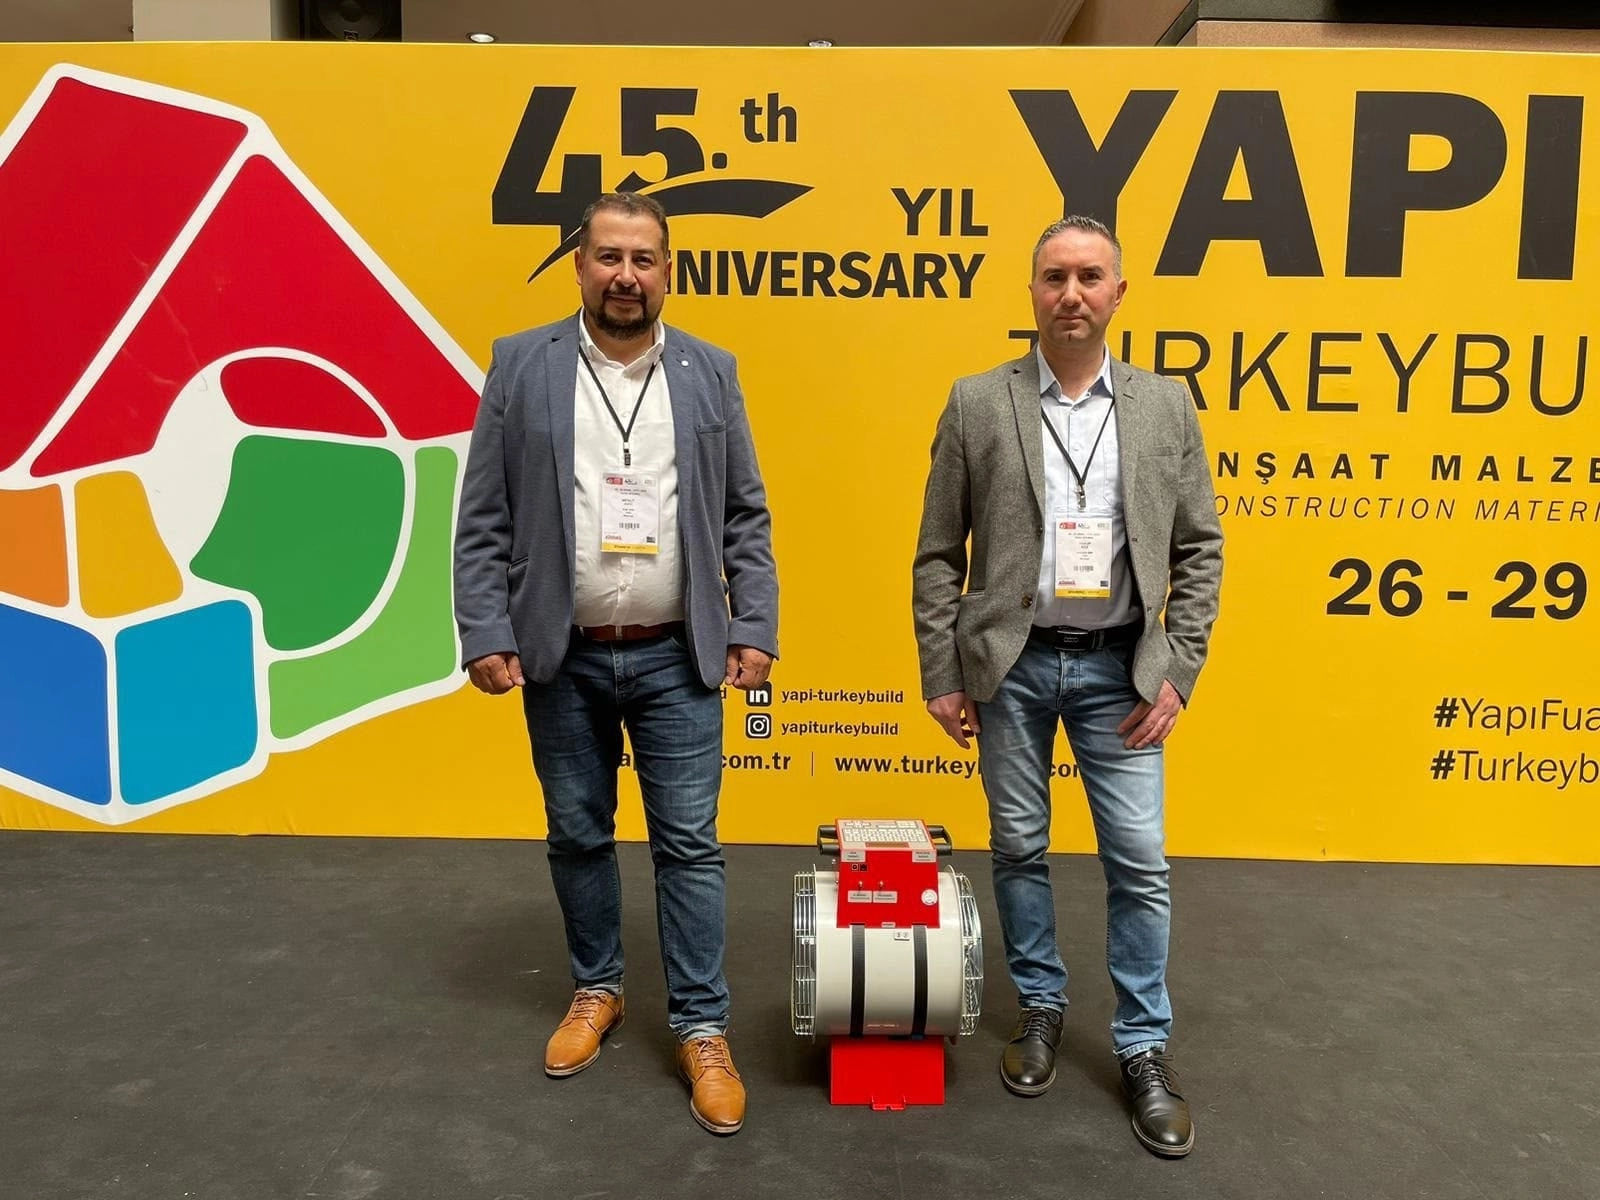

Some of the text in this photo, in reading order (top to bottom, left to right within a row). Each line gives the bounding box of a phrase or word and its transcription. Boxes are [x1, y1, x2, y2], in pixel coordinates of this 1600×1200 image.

[1008, 89, 1584, 280] YAPI
[891, 188, 988, 237] YIL
[667, 249, 986, 298] NIVERSARY
[1326, 557, 1424, 617] 26
[1491, 560, 1588, 620] 29
[781, 688, 904, 705] yapi-turkeybuild
[781, 721, 899, 737] yapiturkeybuild
[834, 755, 981, 779] www.turkey
[1430, 749, 1600, 790] #Turkeyb
